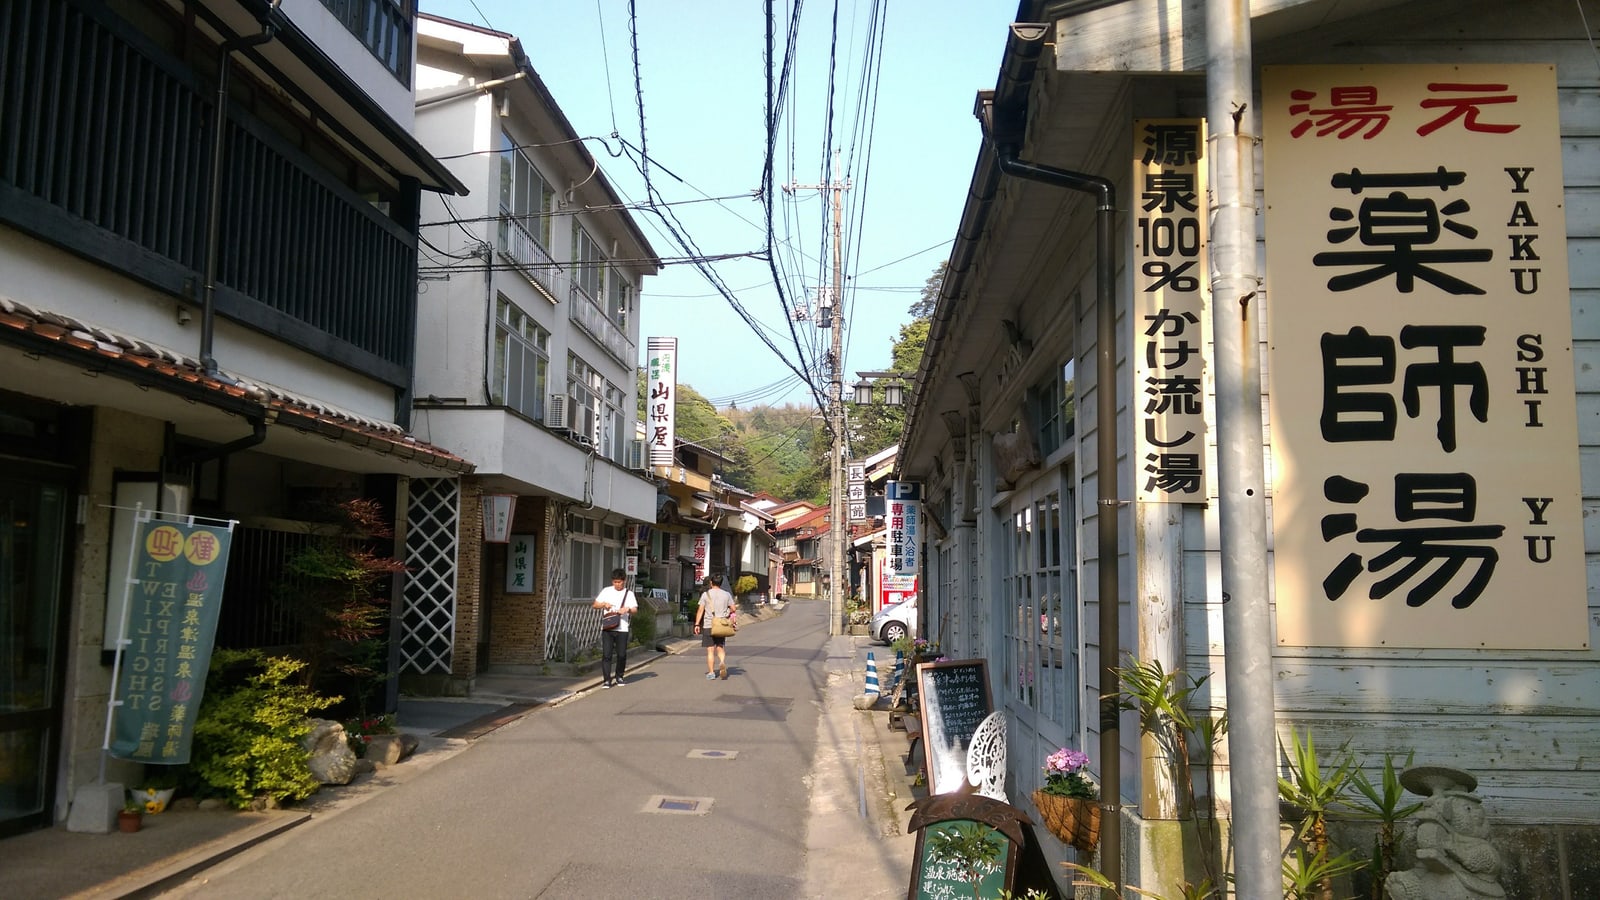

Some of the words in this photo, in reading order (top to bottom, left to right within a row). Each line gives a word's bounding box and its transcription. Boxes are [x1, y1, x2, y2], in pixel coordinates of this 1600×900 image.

[1290, 83, 1521, 140] 湯元
[1504, 167, 1541, 295] YAKU
[1143, 308, 1203, 495] かけ流し湯
[1312, 164, 1505, 610] 薬師湯
[1516, 334, 1549, 427] SHI
[850, 467, 865, 518] 長命館
[895, 482, 913, 498] P
[890, 503, 904, 571] 専用駐車場
[905, 504, 916, 568] 薬師湯入浴者
[1522, 498, 1556, 564] YU
